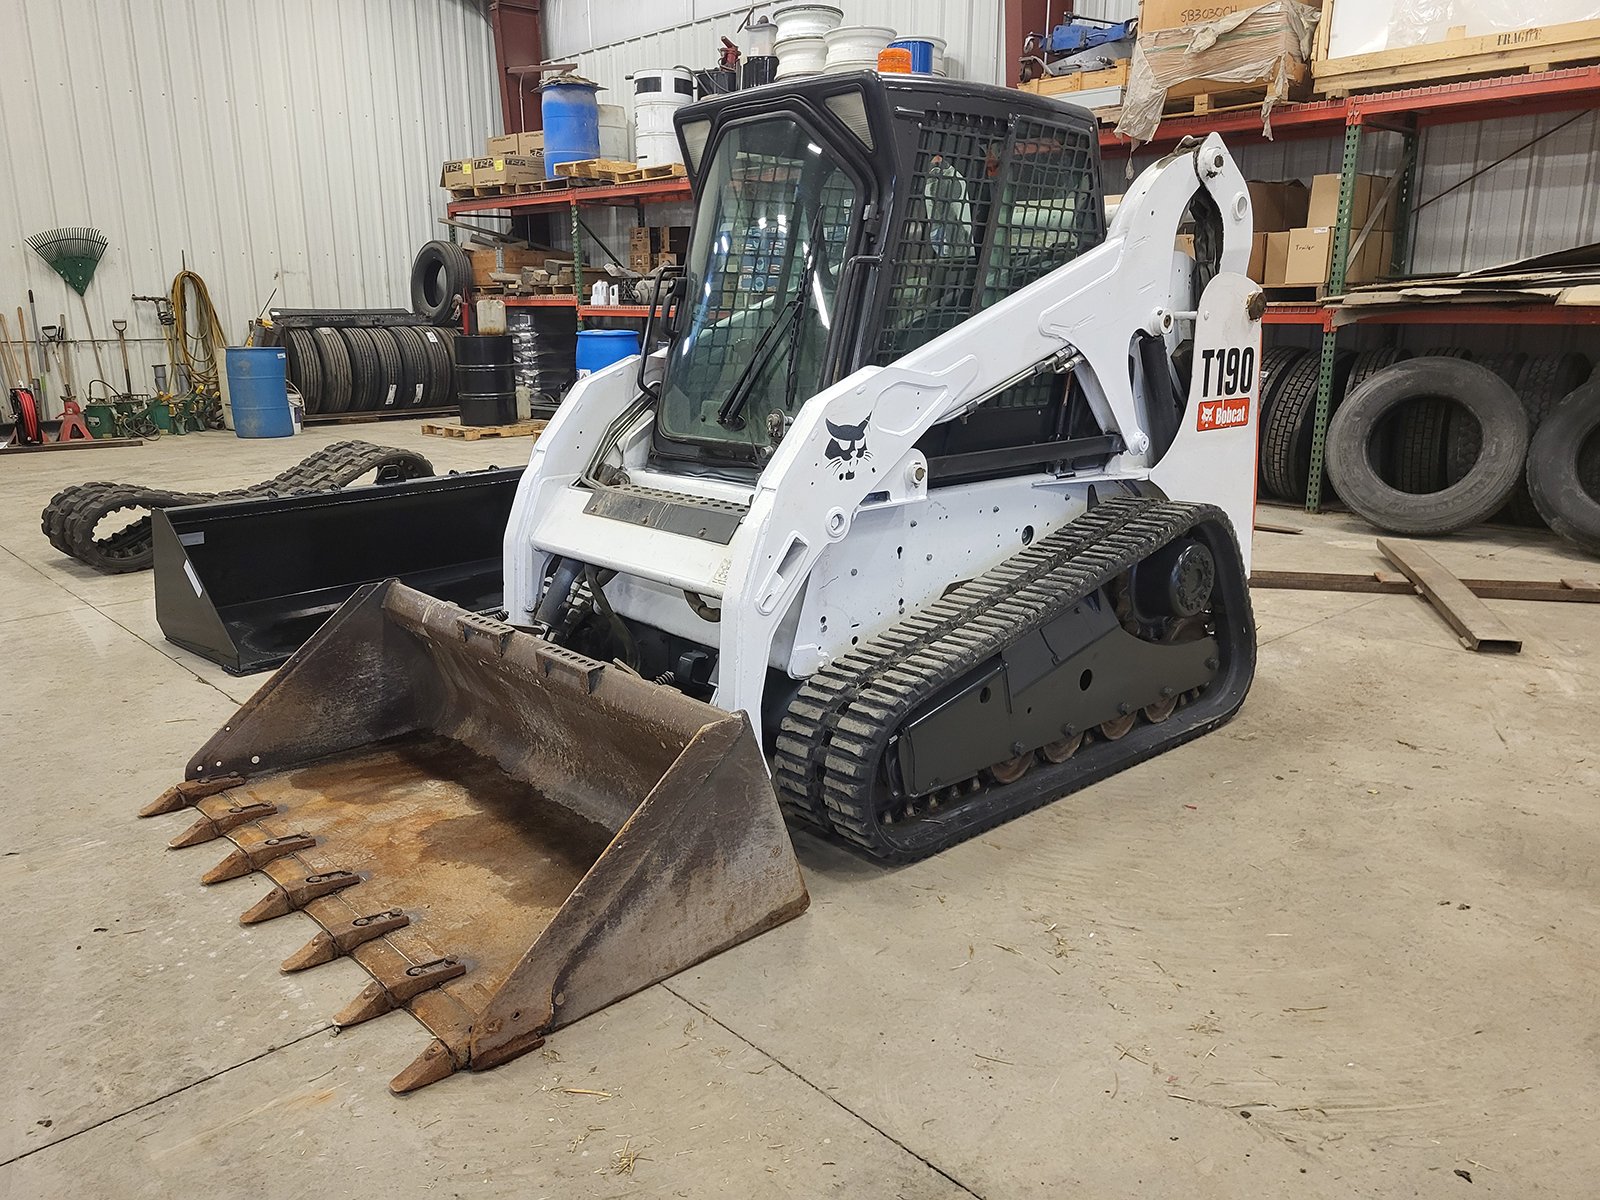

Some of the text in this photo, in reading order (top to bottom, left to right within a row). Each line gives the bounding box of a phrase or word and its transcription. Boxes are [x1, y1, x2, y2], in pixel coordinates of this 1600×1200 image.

[446, 162, 462, 172] TRP
[474, 159, 494, 169] TRP
[1202, 347, 1255, 397] T190
[1215, 406, 1245, 425] Bobcat
